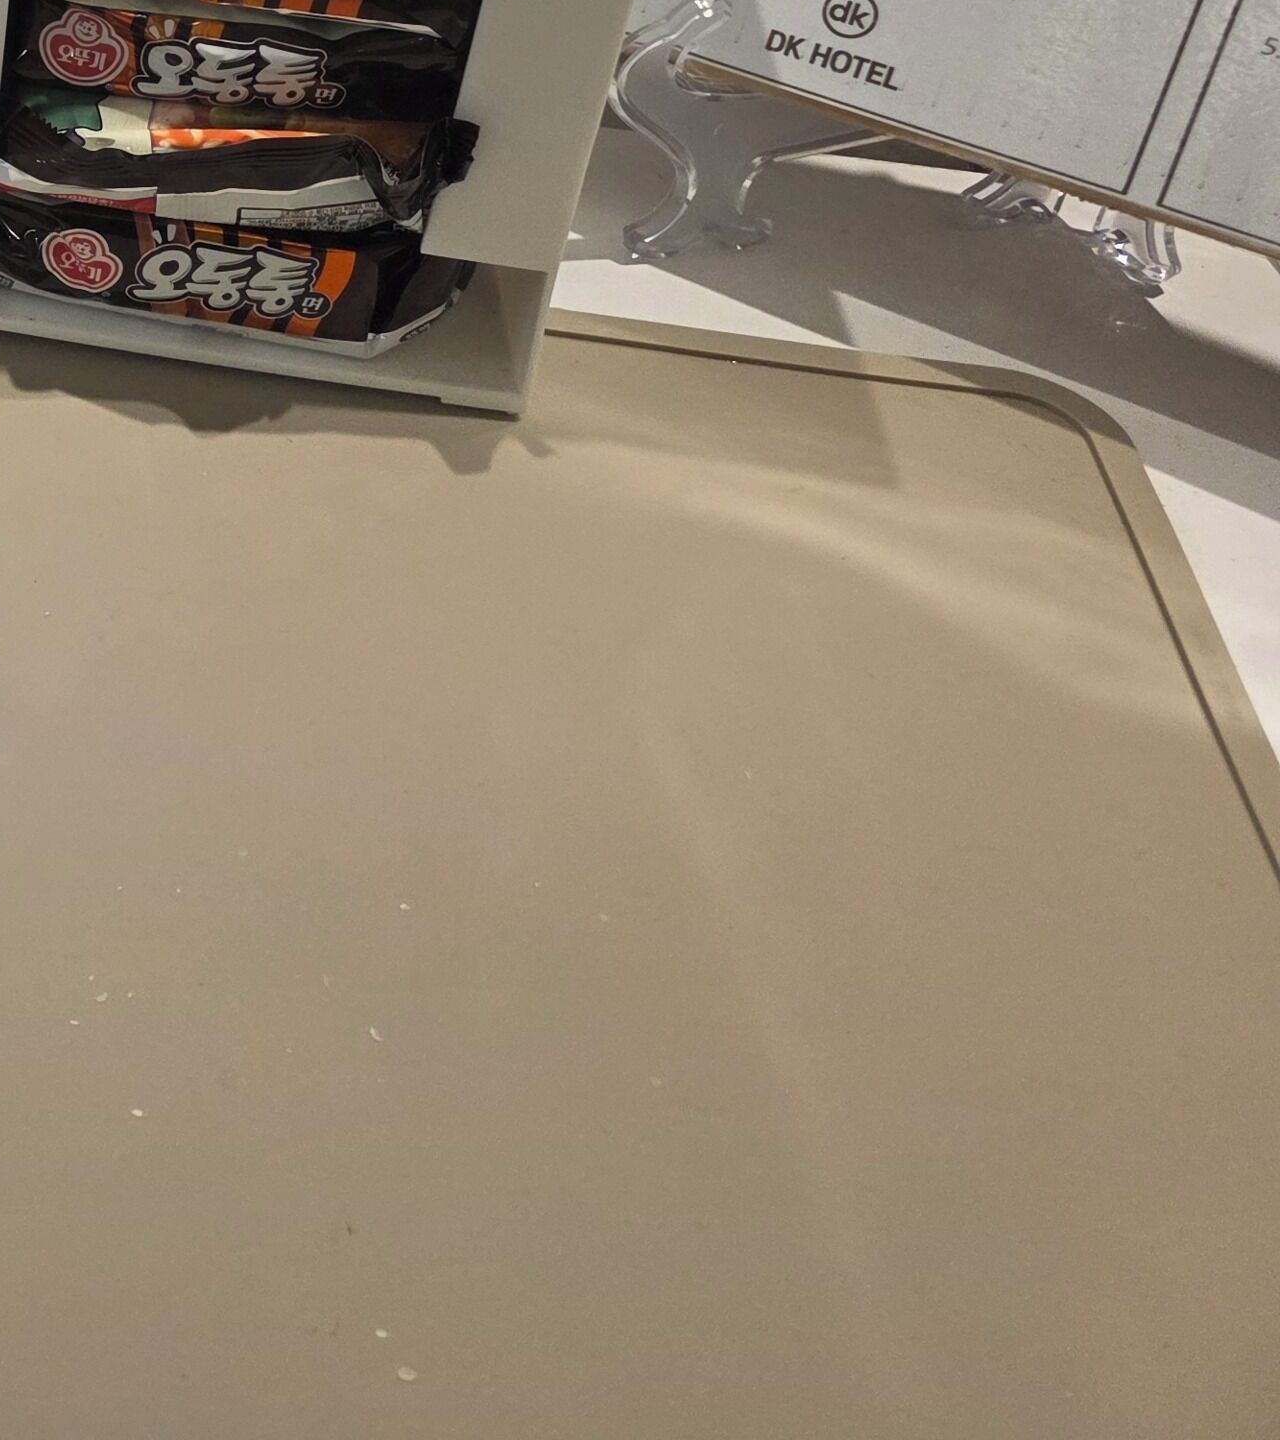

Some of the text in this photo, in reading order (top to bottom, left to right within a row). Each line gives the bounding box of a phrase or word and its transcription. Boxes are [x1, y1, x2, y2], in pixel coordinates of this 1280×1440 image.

[828, 0, 870, 30] dk
[57, 42, 108, 73] 오뚜기
[764, 29, 900, 92] DK HOTEL
